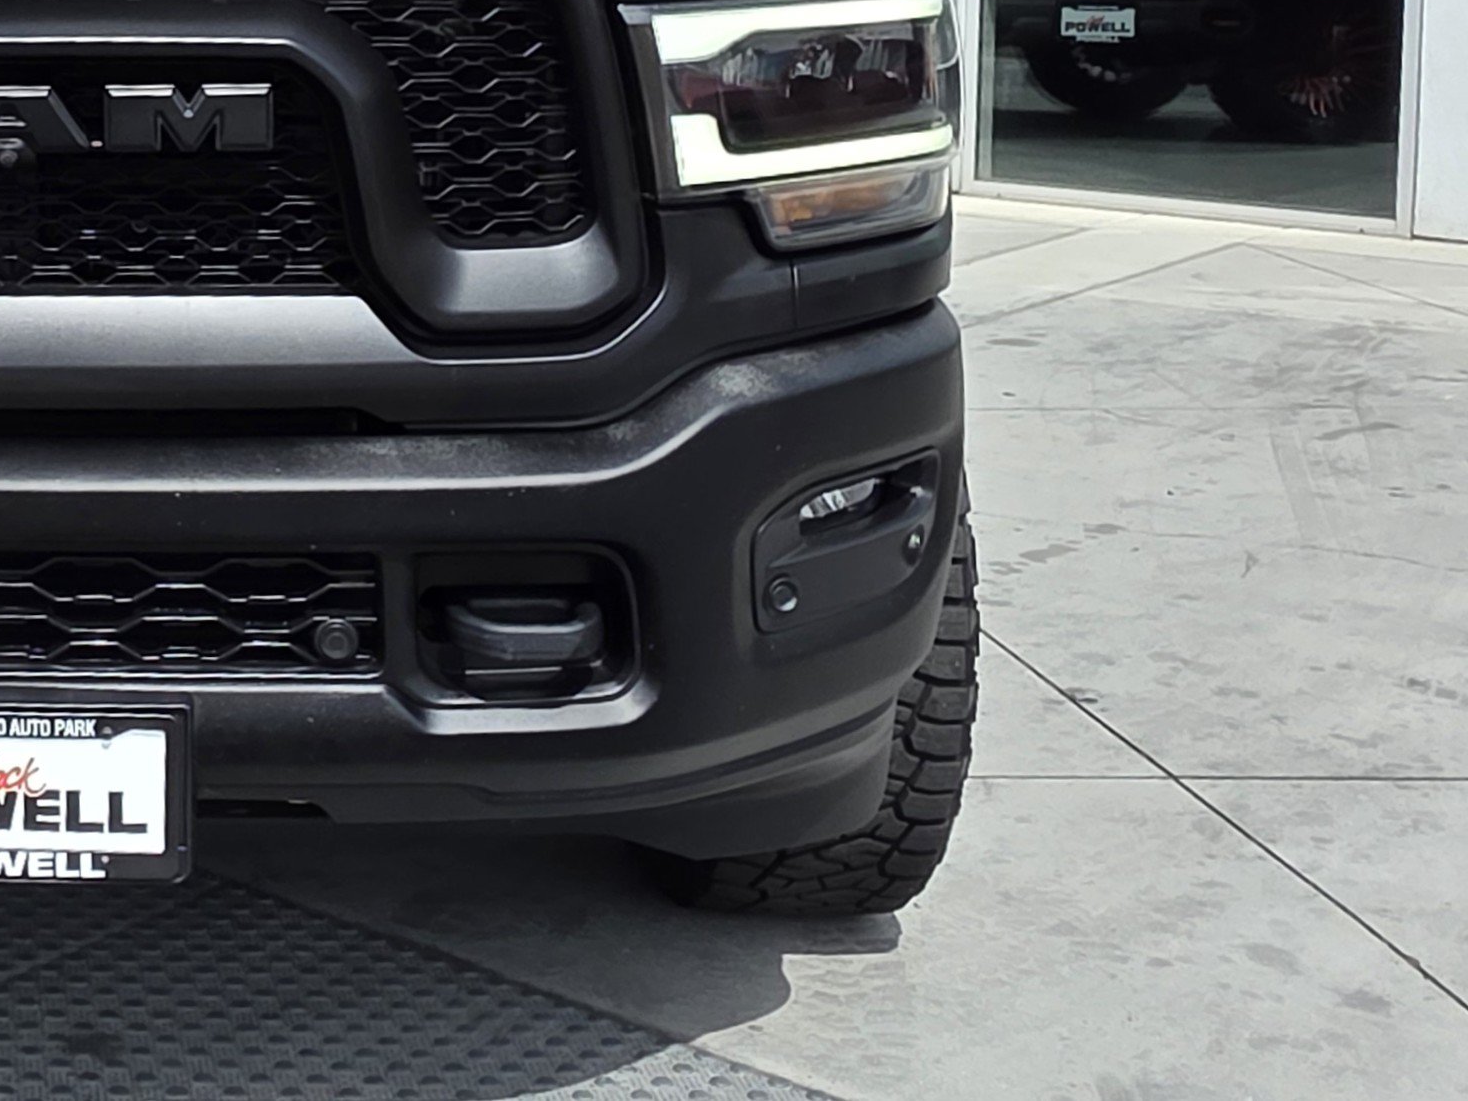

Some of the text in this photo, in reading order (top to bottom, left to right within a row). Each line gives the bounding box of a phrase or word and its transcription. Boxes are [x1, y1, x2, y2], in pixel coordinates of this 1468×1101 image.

[1064, 20, 1131, 33] POWELL
[9, 717, 51, 738] AUTO
[53, 718, 97, 738] PARK
